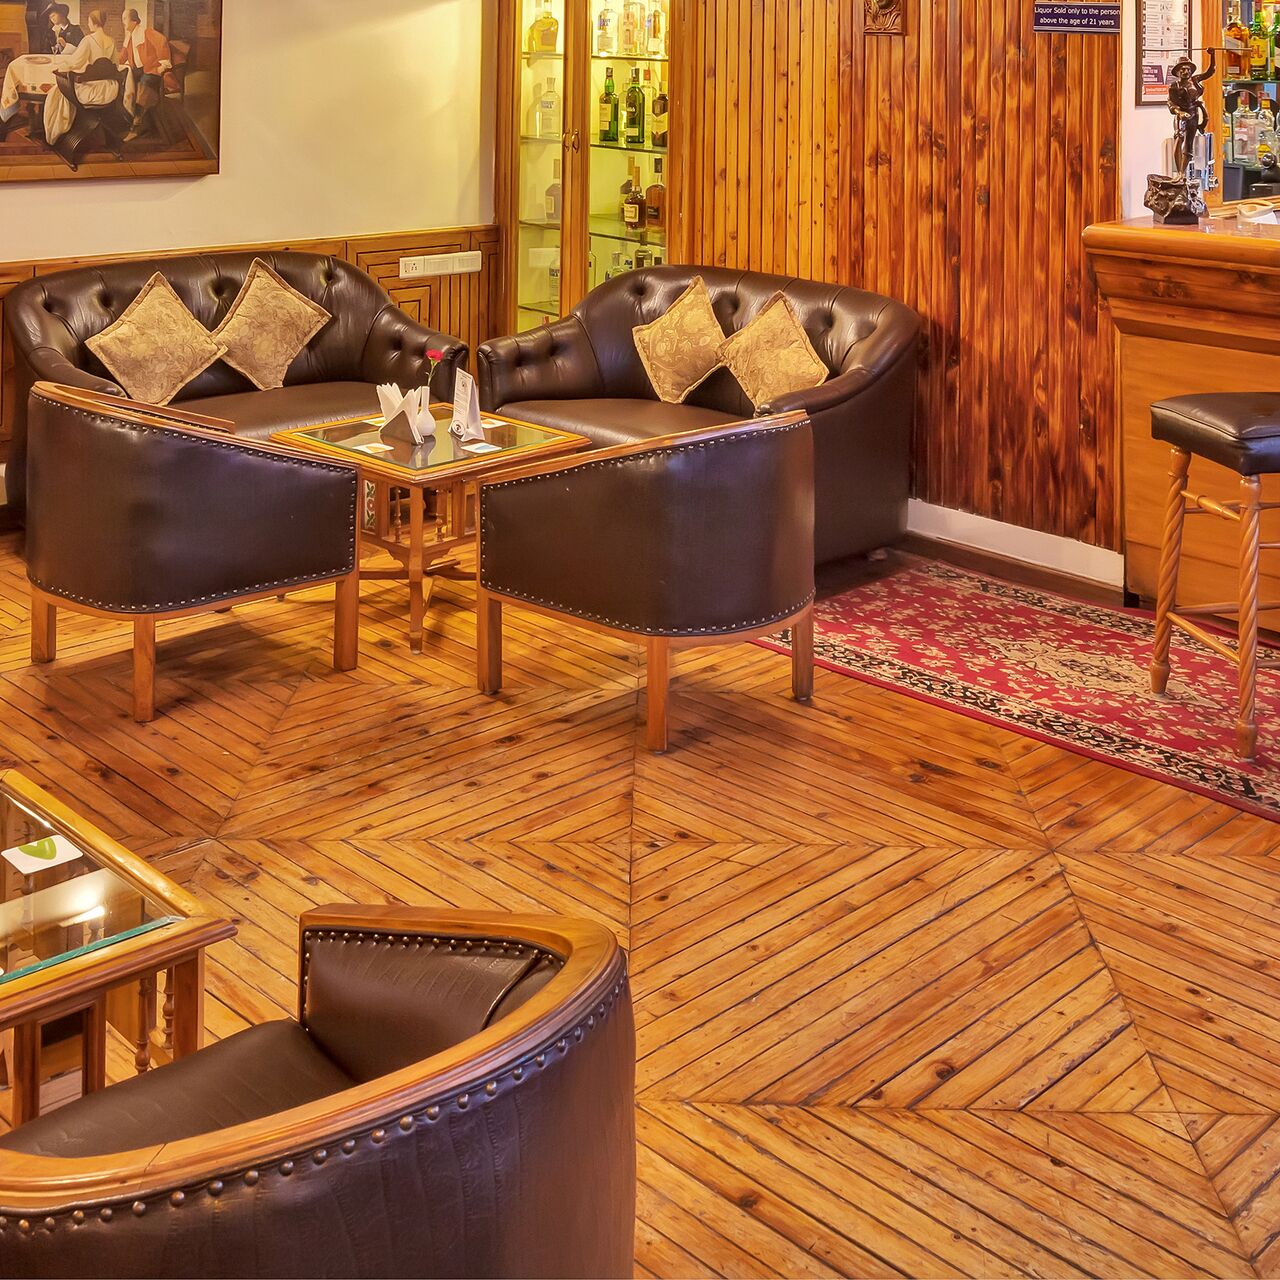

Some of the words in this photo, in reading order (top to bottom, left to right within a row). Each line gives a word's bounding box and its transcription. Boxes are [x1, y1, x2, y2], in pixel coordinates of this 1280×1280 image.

[1034, 6, 1052, 14] Liquor
[1053, 6, 1066, 14] Sold
[1067, 7, 1080, 15] only
[1069, 18, 1080, 26] age
